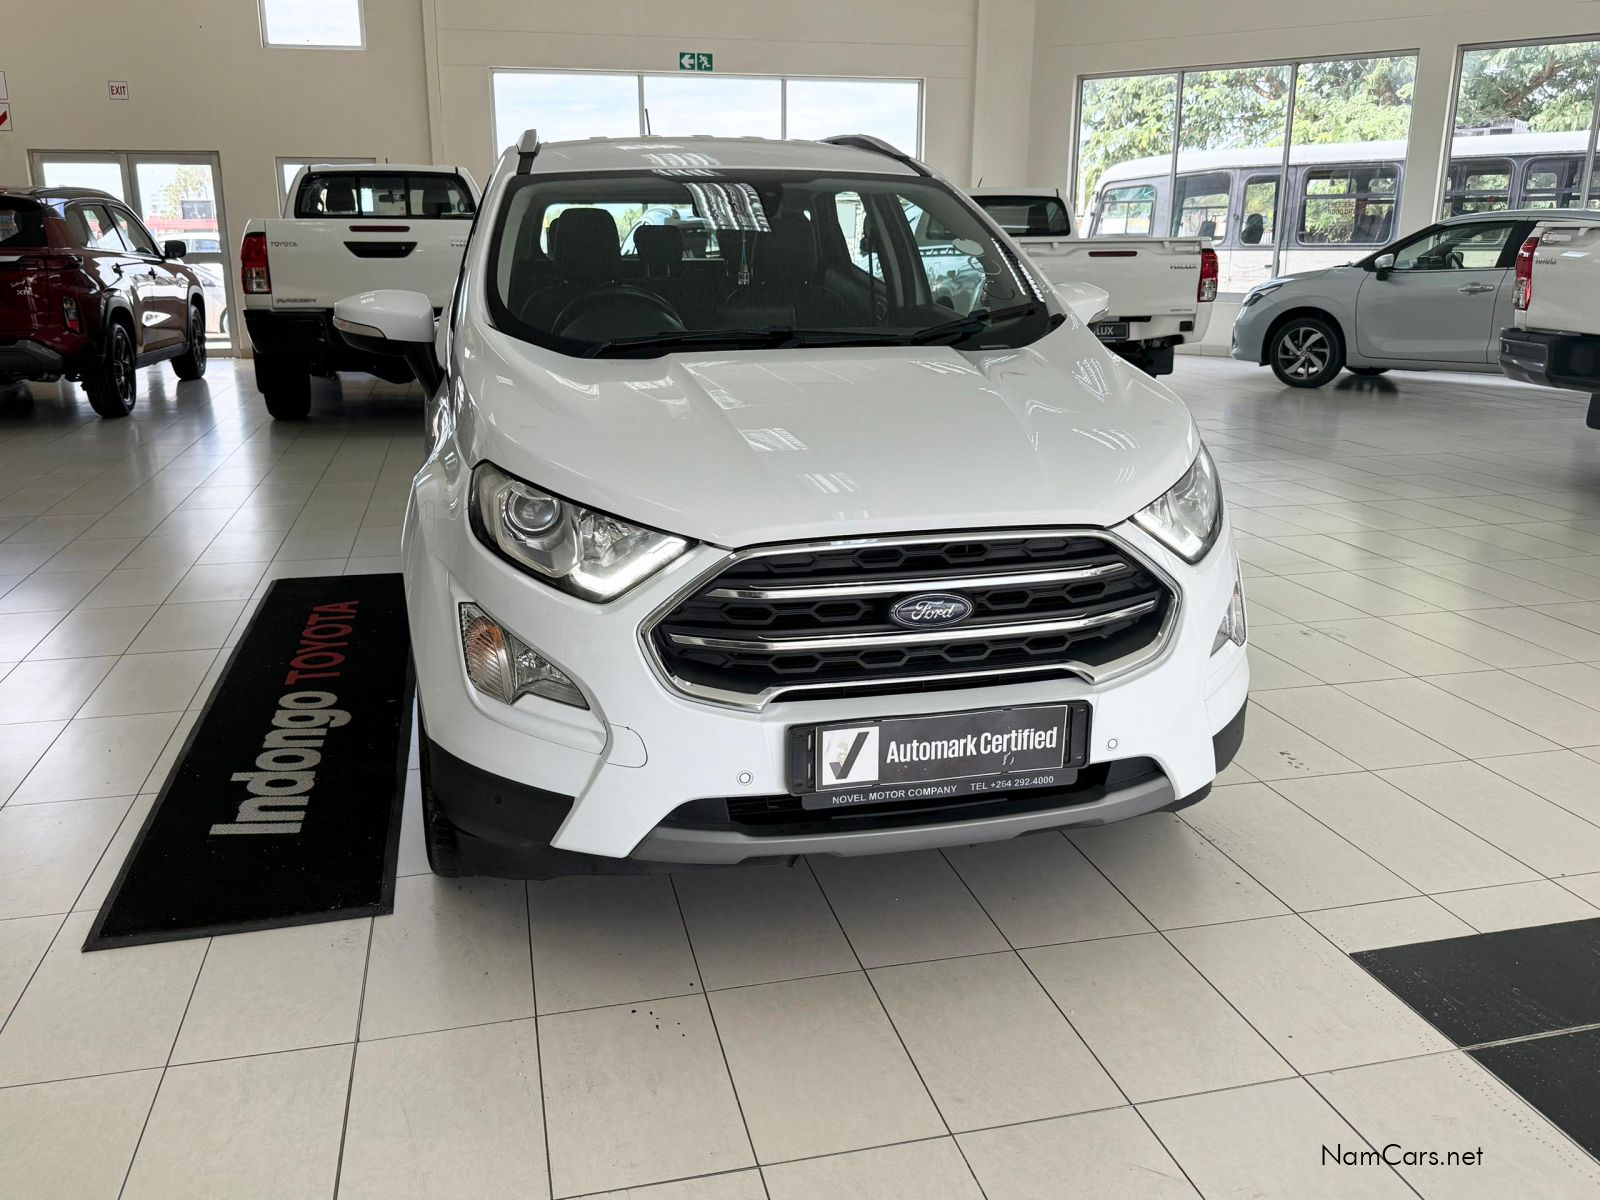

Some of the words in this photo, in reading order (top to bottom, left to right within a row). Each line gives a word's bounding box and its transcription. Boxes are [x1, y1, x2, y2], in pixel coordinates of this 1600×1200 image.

[110, 85, 126, 96] EXIT
[911, 600, 956, 620] Ford
[209, 690, 352, 835] Indongo
[284, 600, 359, 686] TOYOTA
[886, 734, 978, 764] Automark
[979, 726, 1059, 755] Certified
[832, 793, 867, 805] NOVEL
[868, 788, 906, 801] MOTOR
[908, 784, 958, 798] COMPANY
[970, 781, 988, 792] TEL
[990, 778, 1012, 789] +264
[1014, 775, 1055, 788] 292.4000
